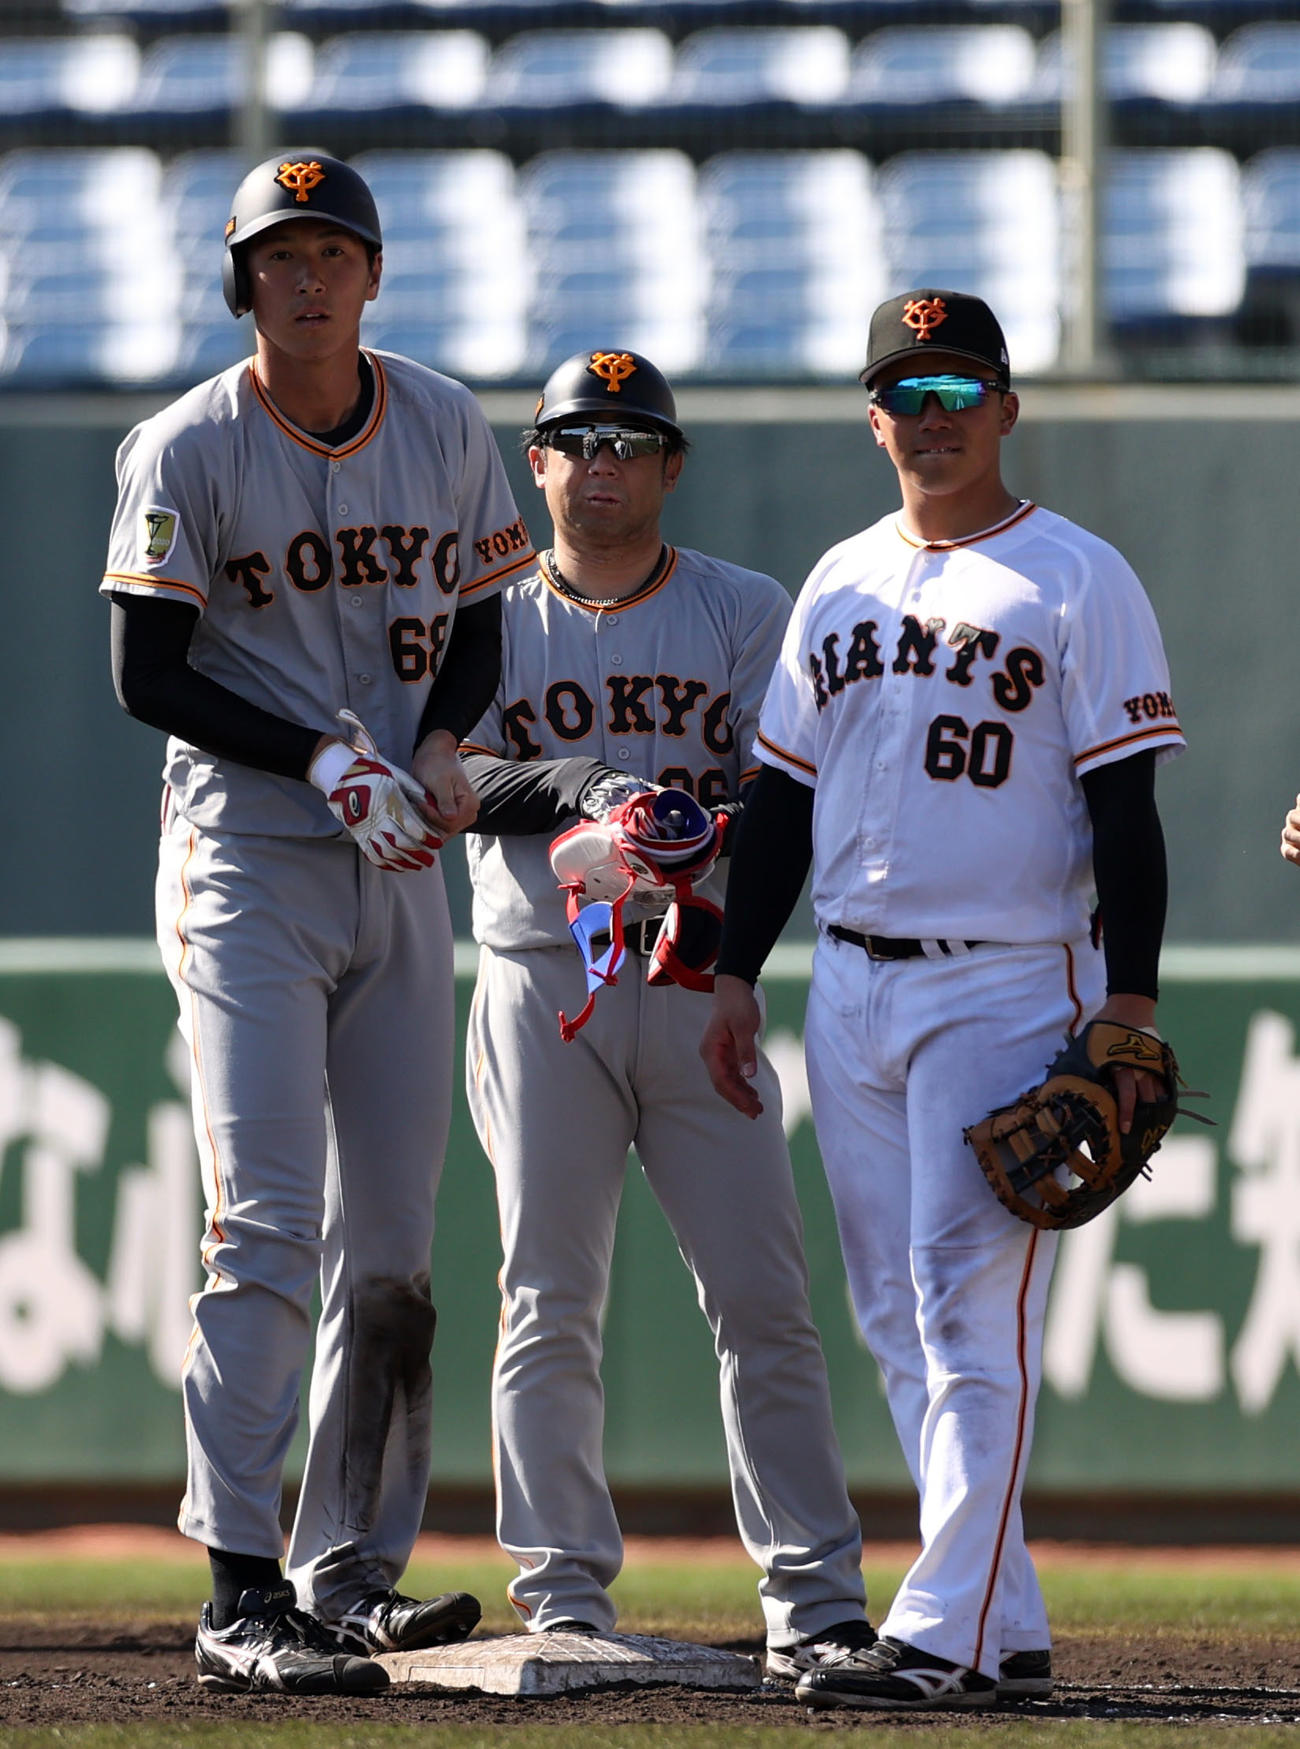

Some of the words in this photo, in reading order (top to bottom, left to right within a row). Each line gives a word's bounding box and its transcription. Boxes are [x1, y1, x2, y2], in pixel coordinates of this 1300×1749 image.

[226, 525, 460, 608] TOKYO
[503, 674, 734, 761] TOKYO
[924, 713, 1014, 789] 60
